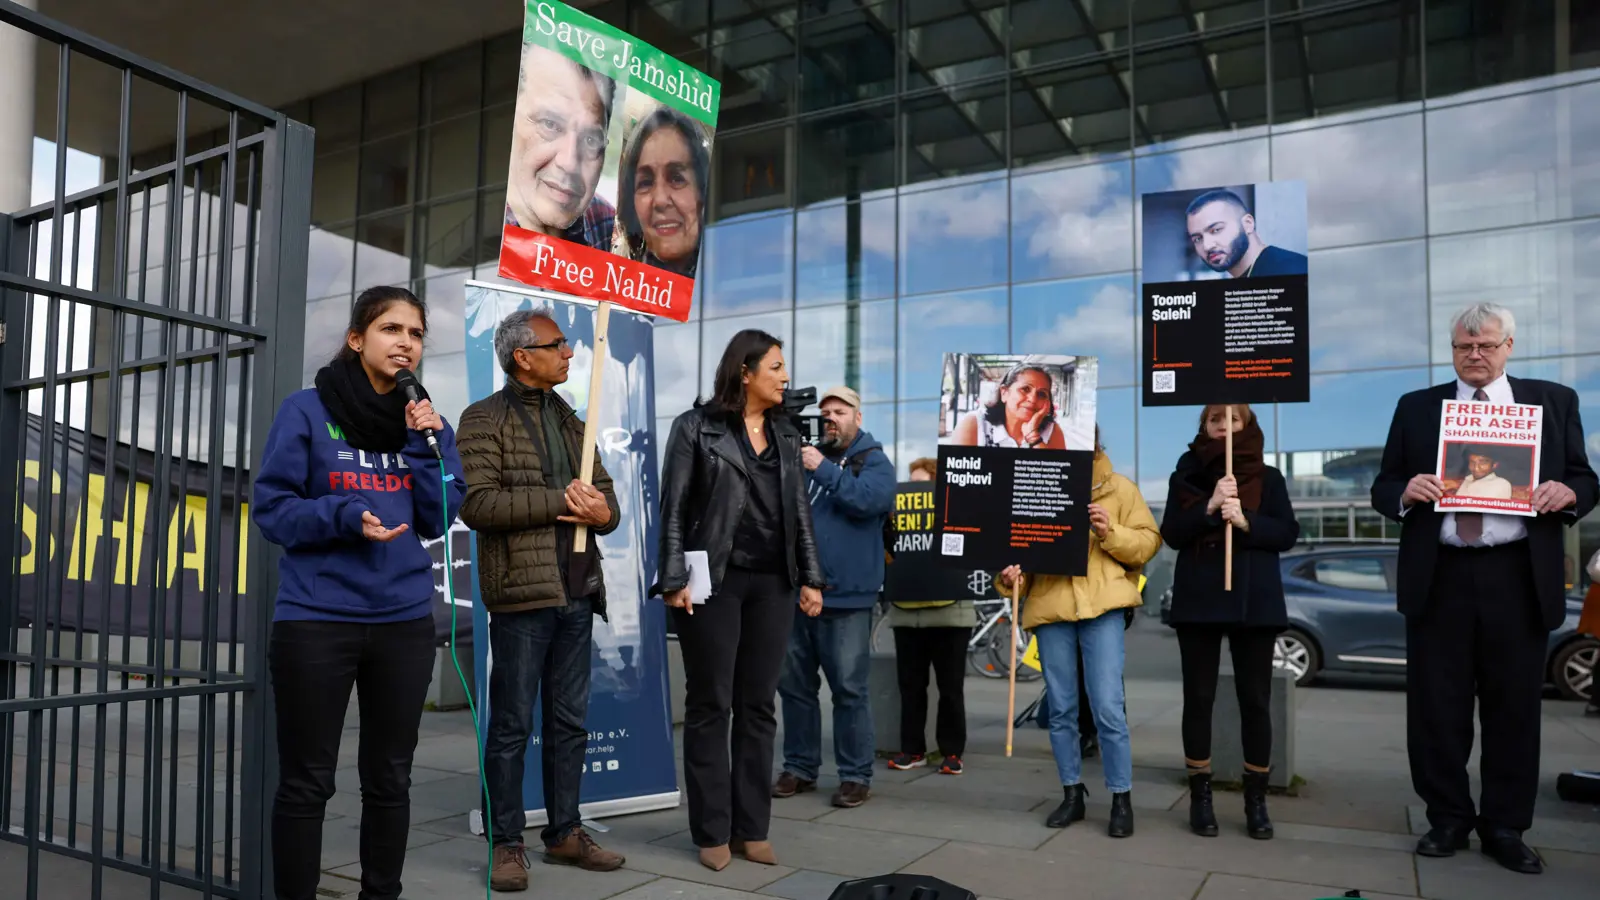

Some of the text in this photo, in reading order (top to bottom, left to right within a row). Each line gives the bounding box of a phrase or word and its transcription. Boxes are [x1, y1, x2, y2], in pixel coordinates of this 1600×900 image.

[536, 2, 713, 113] Save Jamshid
[531, 242, 673, 309] Free Nahid
[1152, 291, 1196, 307] Toomaj
[1152, 306, 1191, 321] Salehi
[1446, 403, 1537, 417] FREIHEIT
[1445, 414, 1537, 430] FÜR ASEF
[1444, 429, 1536, 440] SHAHBAKHSH
[946, 456, 981, 470] Nahid
[329, 472, 413, 492] FREEDO
[945, 471, 992, 487] Taghavi
[896, 491, 935, 511] RTEIL
[1441, 497, 1530, 509] #StopExecutionIran
[895, 512, 921, 531] EN!
[893, 533, 934, 552] HARM
[608, 728, 629, 739] e.V.
